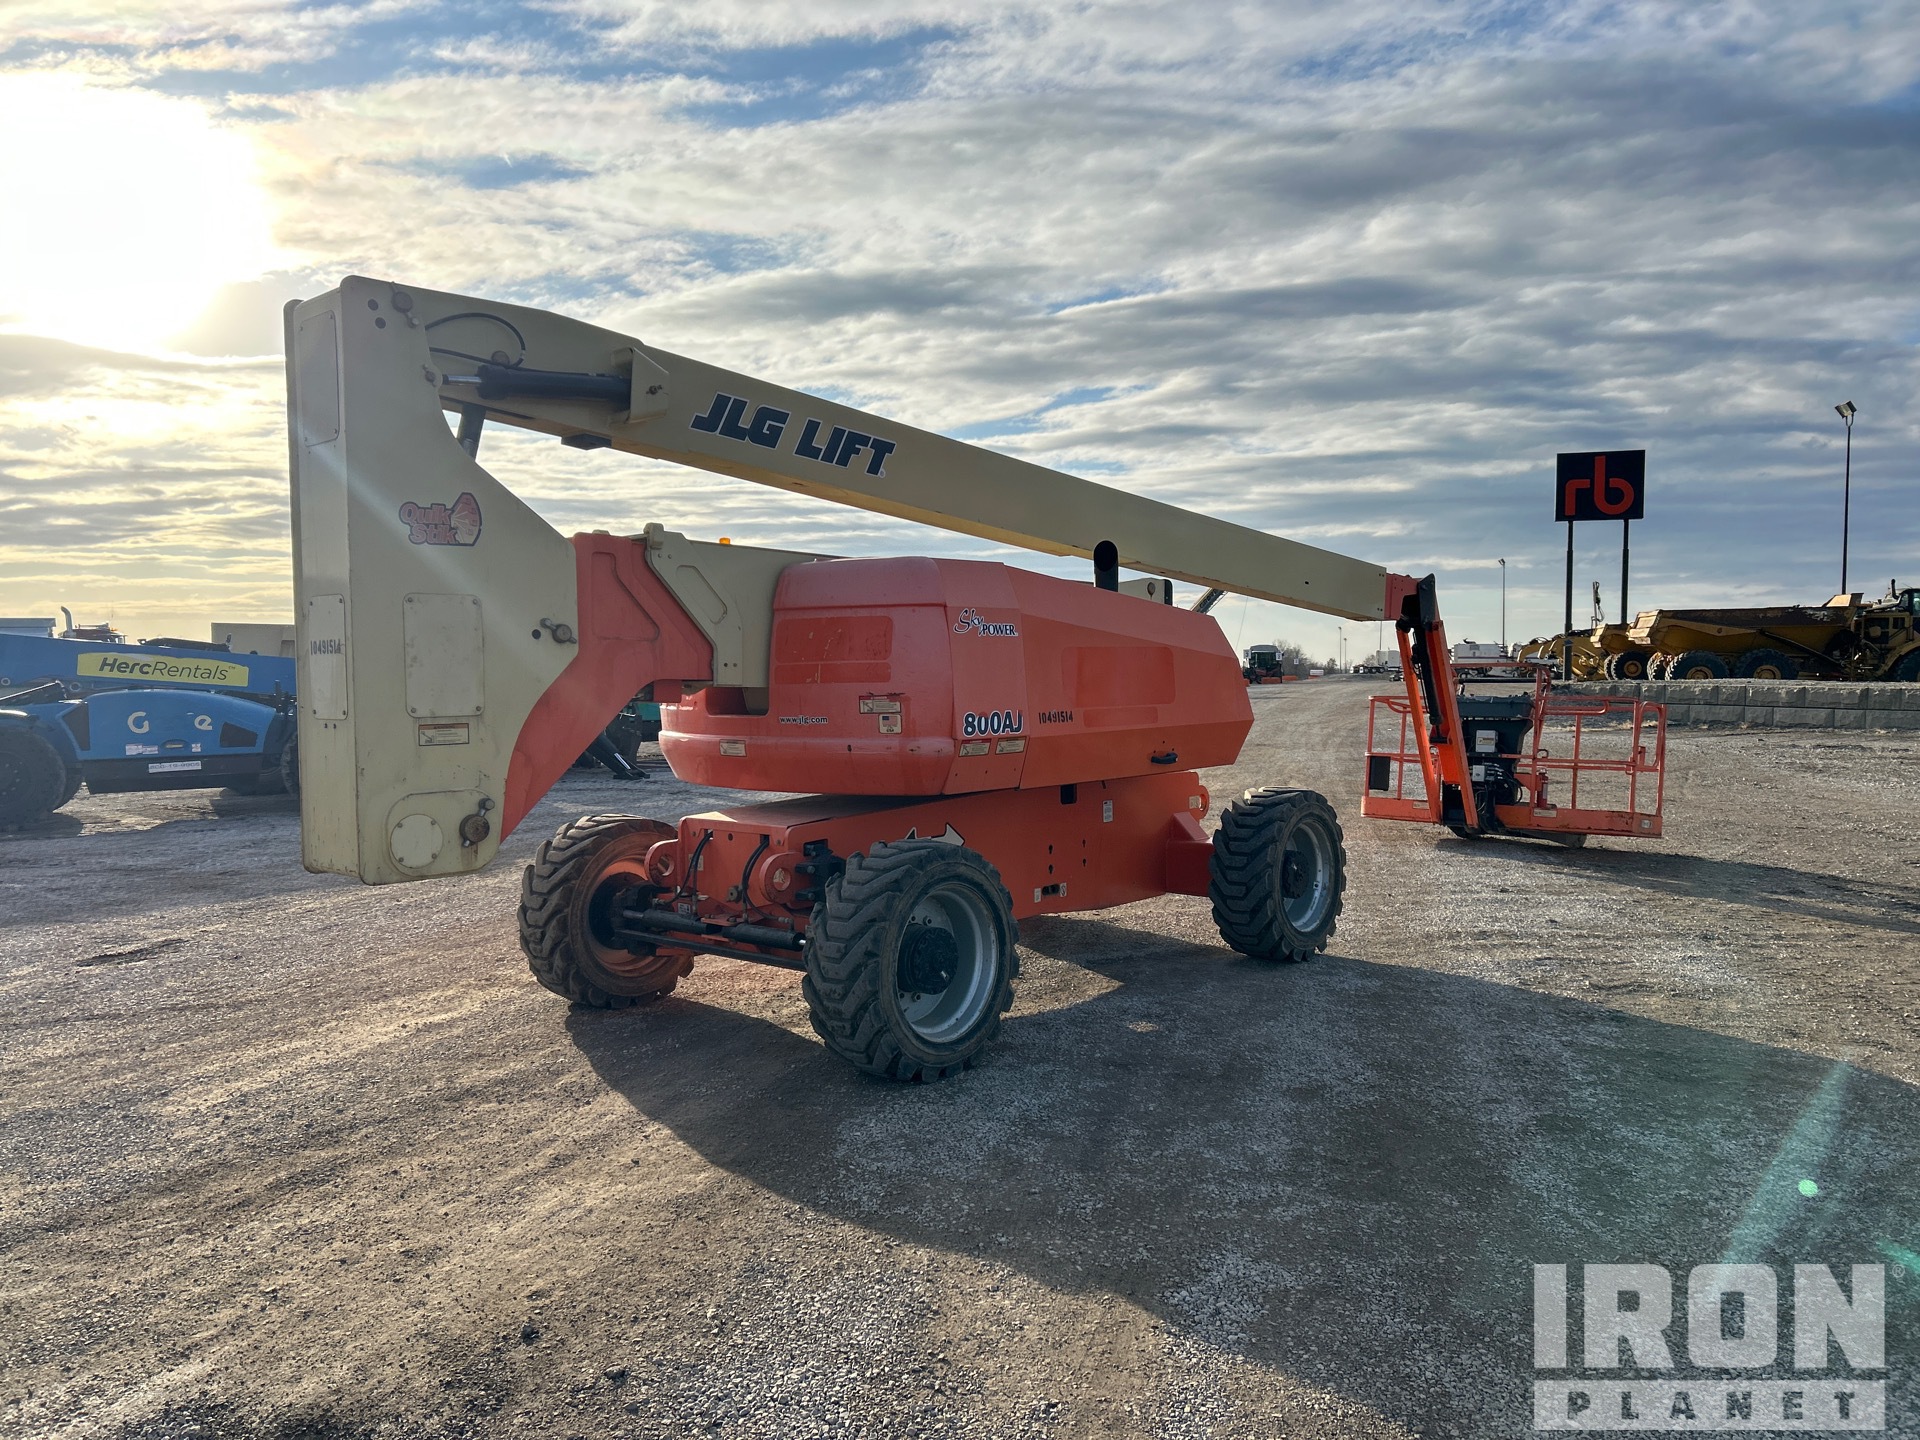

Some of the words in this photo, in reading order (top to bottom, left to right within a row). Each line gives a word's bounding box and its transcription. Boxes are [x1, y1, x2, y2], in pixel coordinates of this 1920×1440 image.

[690, 392, 791, 450] JLG
[1565, 456, 1635, 516] rb
[963, 709, 1023, 737] 800AJ
[1038, 710, 1074, 724] 10491514
